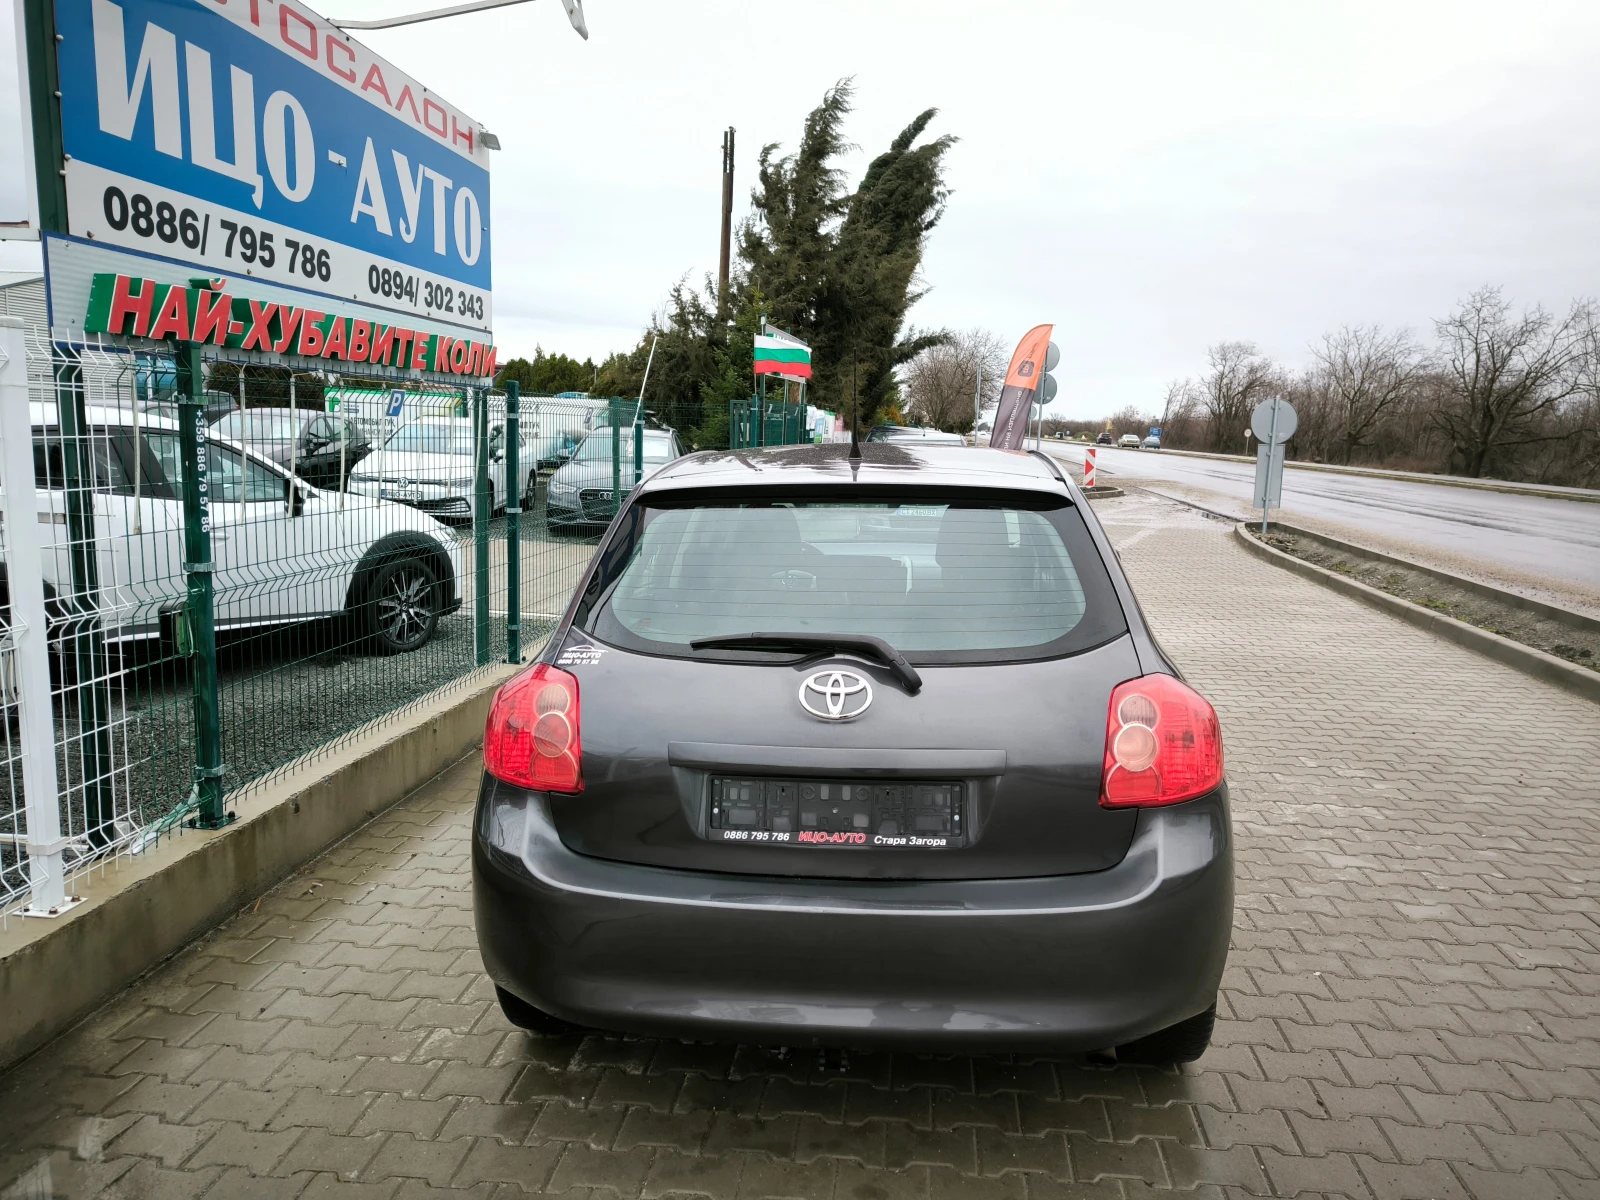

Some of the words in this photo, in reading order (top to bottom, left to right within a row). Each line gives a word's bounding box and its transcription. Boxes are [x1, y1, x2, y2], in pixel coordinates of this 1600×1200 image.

[212, 0, 474, 155] ТОСАЛОН
[103, 186, 210, 256] 0886/
[220, 219, 276, 268] 795
[284, 239, 332, 283] 786
[368, 264, 420, 308] 0894/
[424, 285, 454, 311] 302
[458, 295, 484, 321] 343
[106, 274, 430, 371] НАЙ-ХУБАВИТЕ
[435, 335, 498, 378] КОЛИ
[195, 409, 205, 443] +359
[196, 447, 206, 472] 886
[198, 476, 208, 492] 79
[200, 497, 209, 511] 57
[201, 516, 211, 533] 86
[723, 831, 748, 841] 0886
[750, 831, 769, 841] 795
[771, 832, 790, 842] 786
[798, 831, 866, 844] ИЦО-АУТО
[874, 835, 907, 847] Стара
[908, 836, 947, 847] Загора
